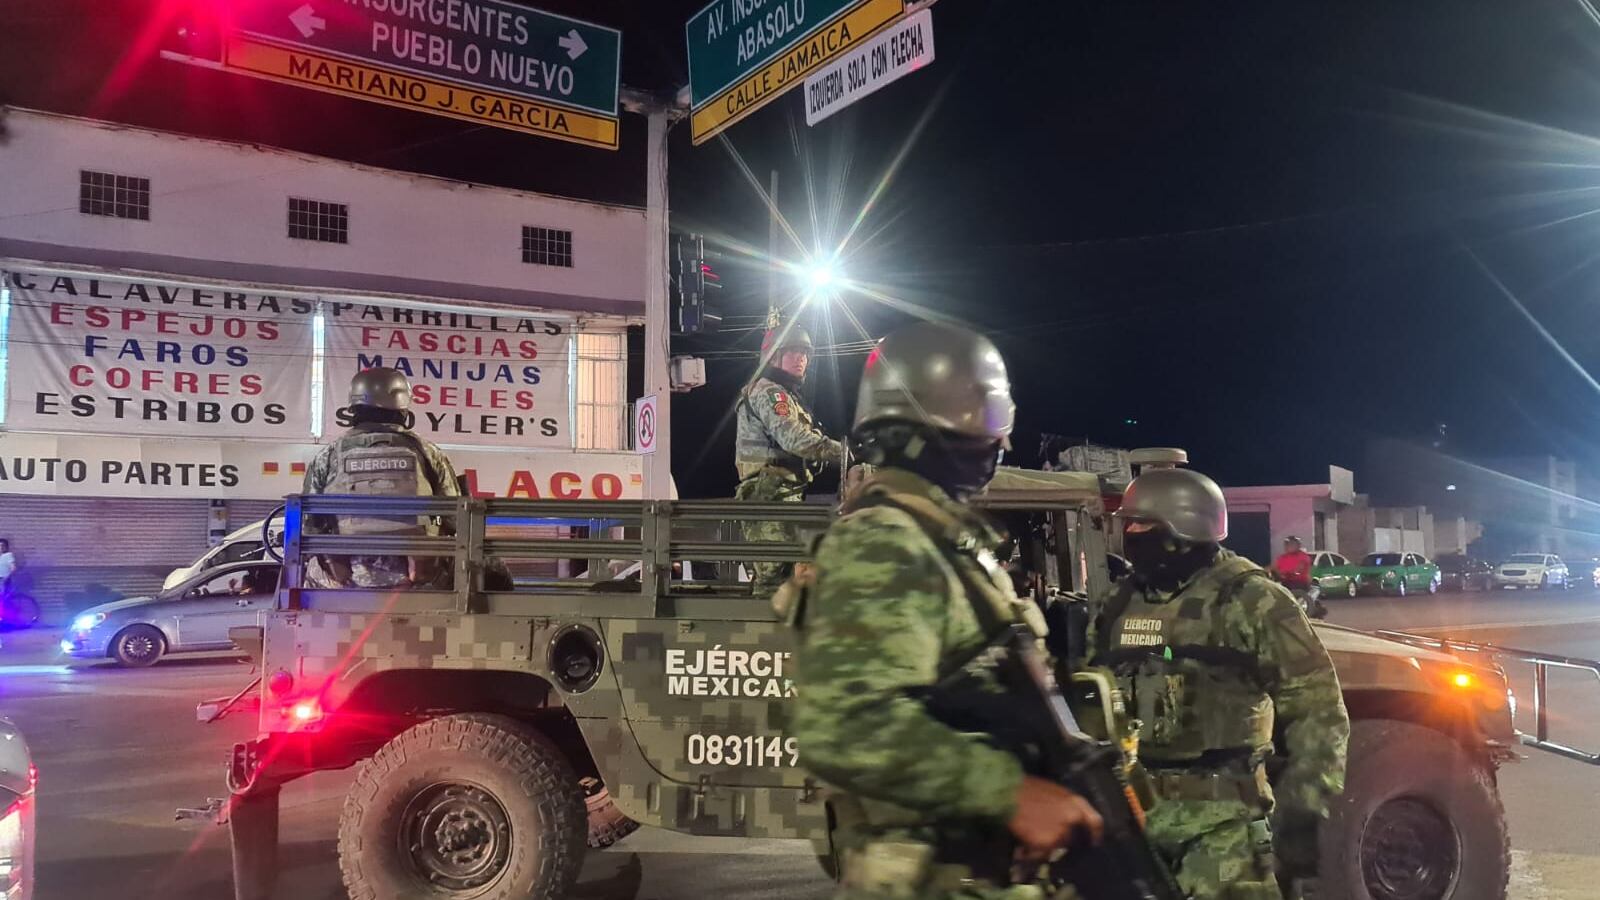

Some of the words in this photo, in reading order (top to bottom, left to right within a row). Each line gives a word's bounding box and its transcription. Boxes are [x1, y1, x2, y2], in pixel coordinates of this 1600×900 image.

[344, 0, 529, 45] URGENTES
[707, 4, 728, 45] AV.
[737, 0, 804, 66] ABASOLO
[372, 21, 481, 75] PUEBLO
[490, 52, 574, 96] NUEVO
[727, 73, 771, 115] CALLE
[777, 22, 852, 84] JAMAICA
[809, 67, 844, 115] IZQUIERDA
[848, 54, 866, 93] SOLO
[871, 42, 888, 80] CON
[891, 23, 924, 70] FLECHA
[289, 54, 427, 103] MARIANO
[437, 90, 459, 110] J.
[470, 96, 569, 133] GARCIA
[12, 272, 313, 314] CALAVERAS
[50, 302, 280, 340] ESPEJOS
[332, 302, 562, 335] PARRILLAS
[84, 335, 249, 367] FAROS
[361, 326, 538, 360] FASCIAS
[69, 364, 263, 395] COFRES
[357, 353, 541, 385] MANIJAS
[35, 392, 286, 424] ESTRIBOS
[412, 384, 534, 410] SELES
[336, 407, 558, 436] SOYLER'S
[102, 460, 239, 487] PARTES
[1120, 633, 1163, 646] MEXICANO
[665, 644, 792, 677] EJÉRCI
[668, 676, 799, 698] MEXICAN
[687, 734, 799, 767] 0831149
